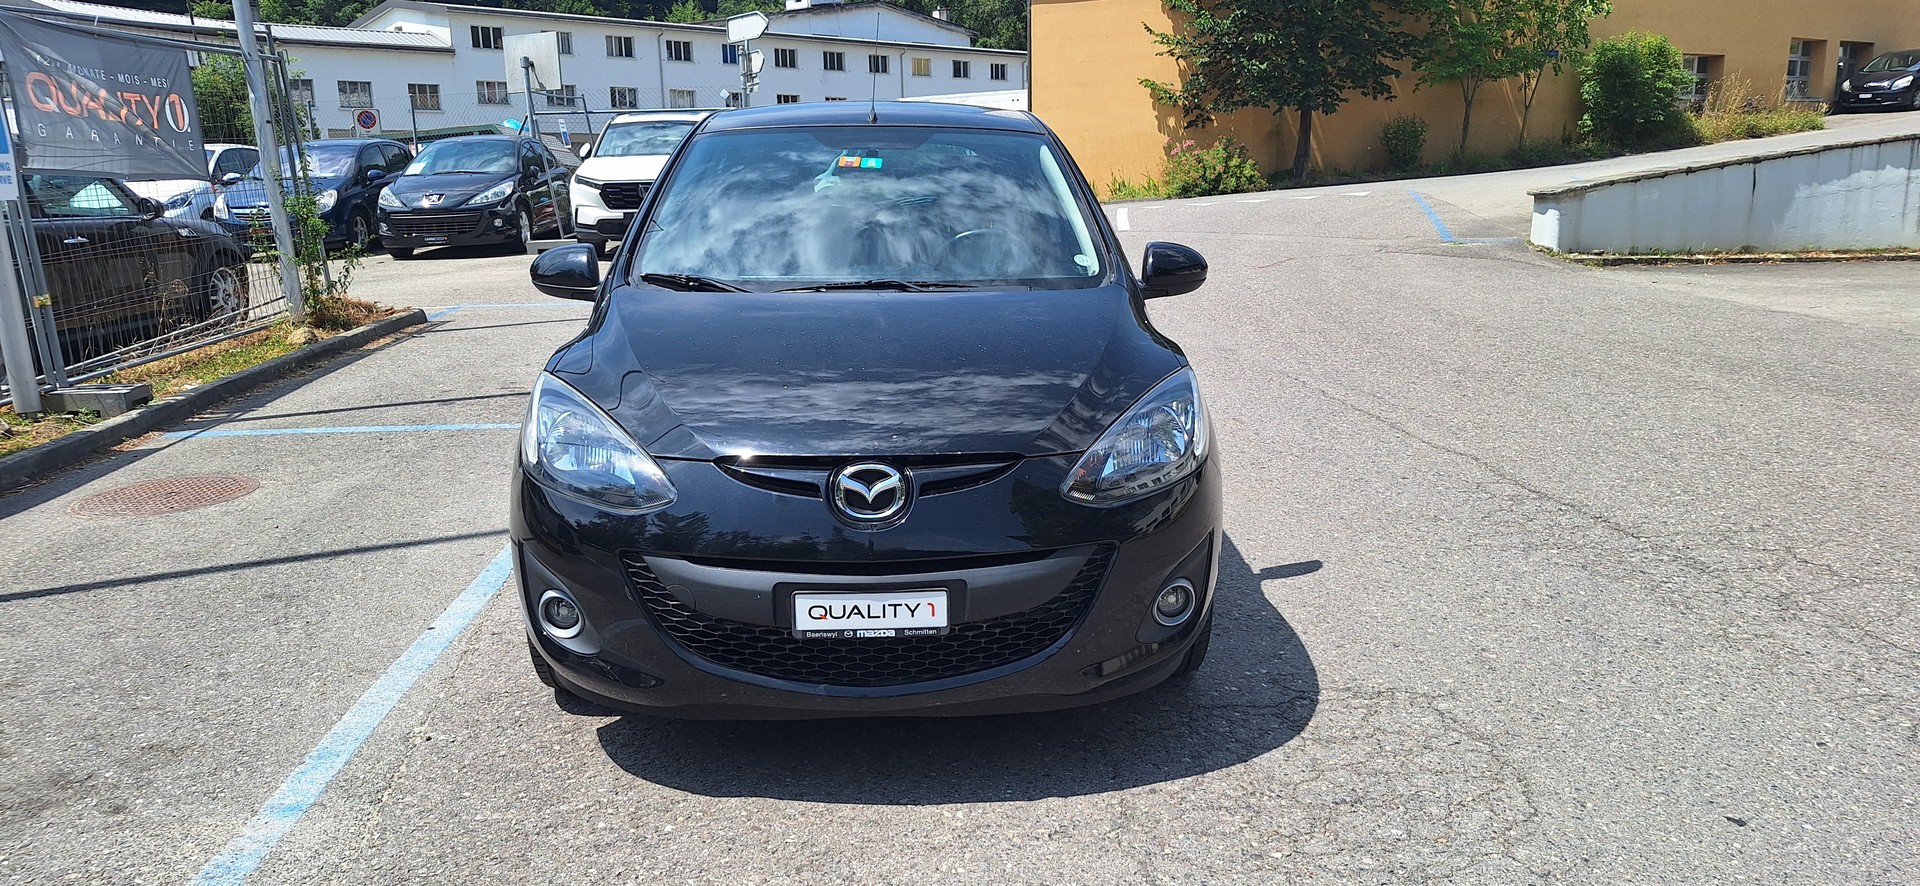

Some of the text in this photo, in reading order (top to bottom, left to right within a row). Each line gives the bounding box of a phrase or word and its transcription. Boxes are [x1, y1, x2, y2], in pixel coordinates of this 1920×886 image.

[117, 72, 140, 86] MOIS
[150, 77, 170, 88] MESI
[37, 123, 195, 151] GARANTIE
[808, 602, 936, 620] QUALITY 1
[806, 631, 838, 639] Baeriswyl
[856, 629, 896, 638] mazda
